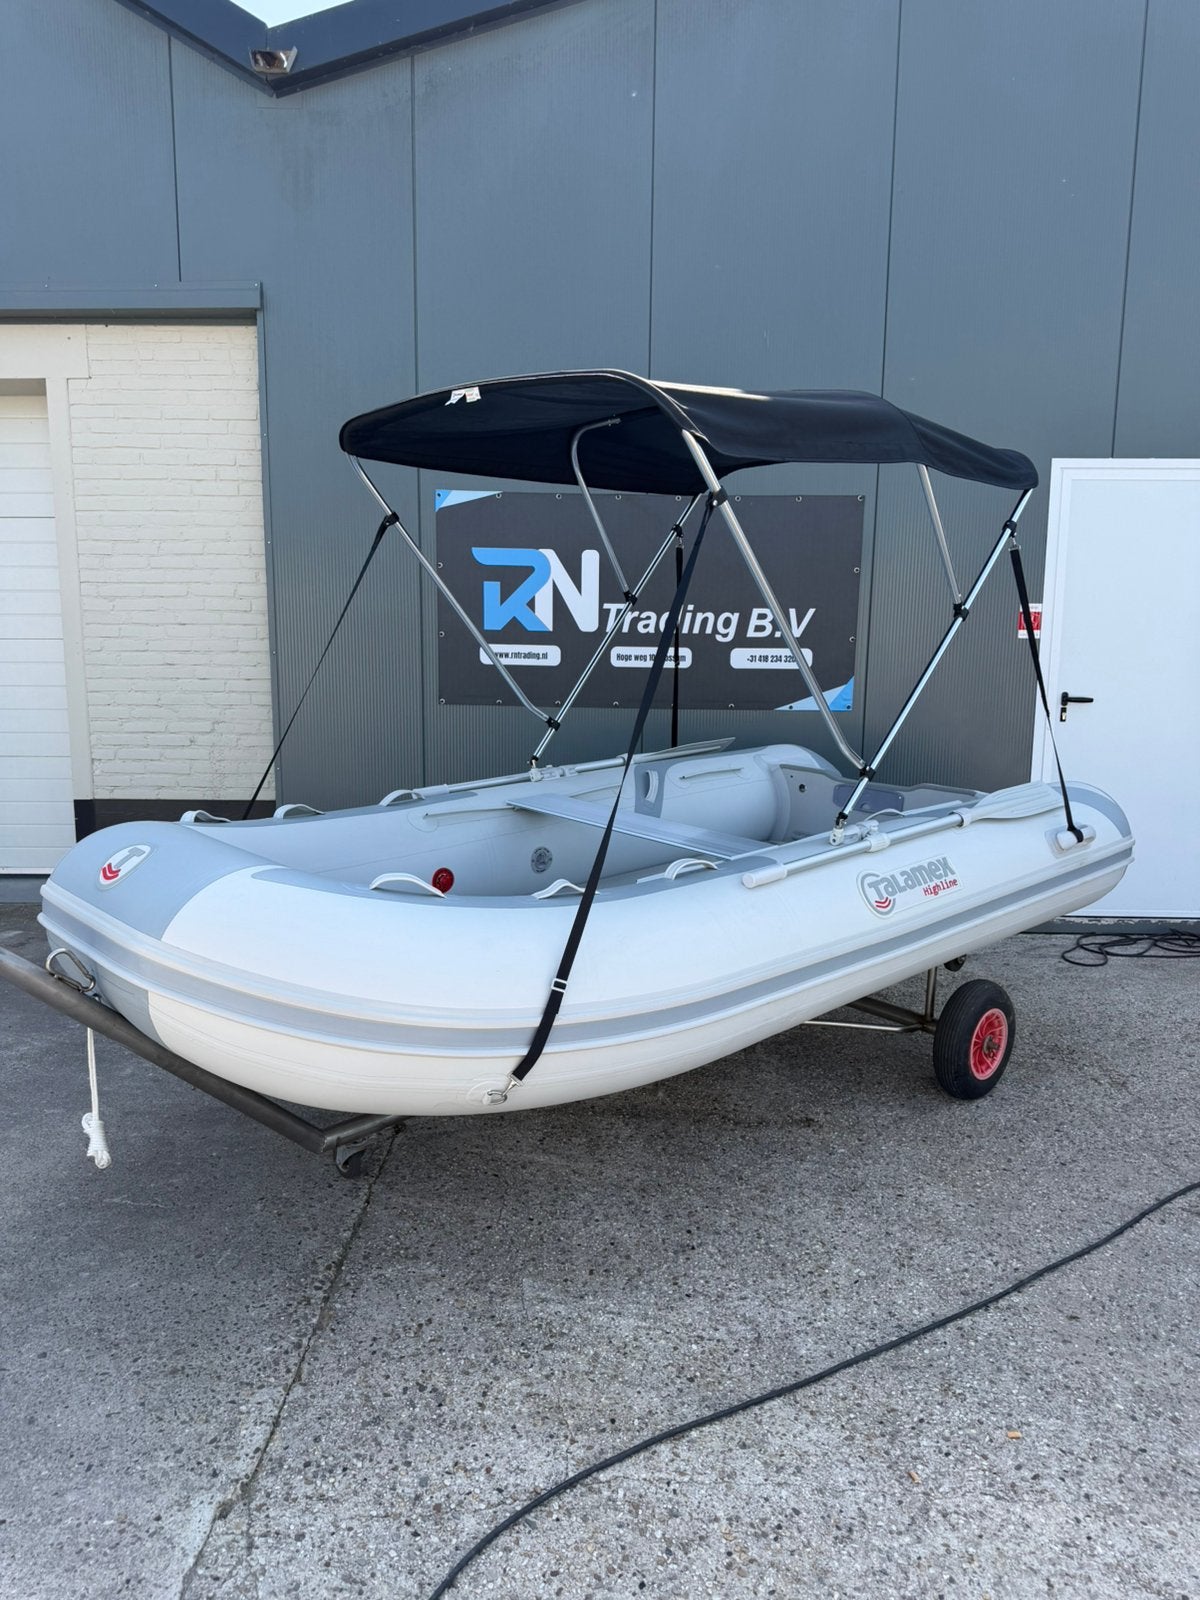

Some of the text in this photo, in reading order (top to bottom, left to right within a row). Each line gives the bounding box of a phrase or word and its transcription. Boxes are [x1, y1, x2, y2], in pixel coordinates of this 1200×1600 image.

[471, 547, 600, 632] RN
[616, 653, 633, 662] Hoge
[758, 655, 769, 663] 418
[770, 655, 783, 663] 234
[923, 878, 958, 896] Highline
